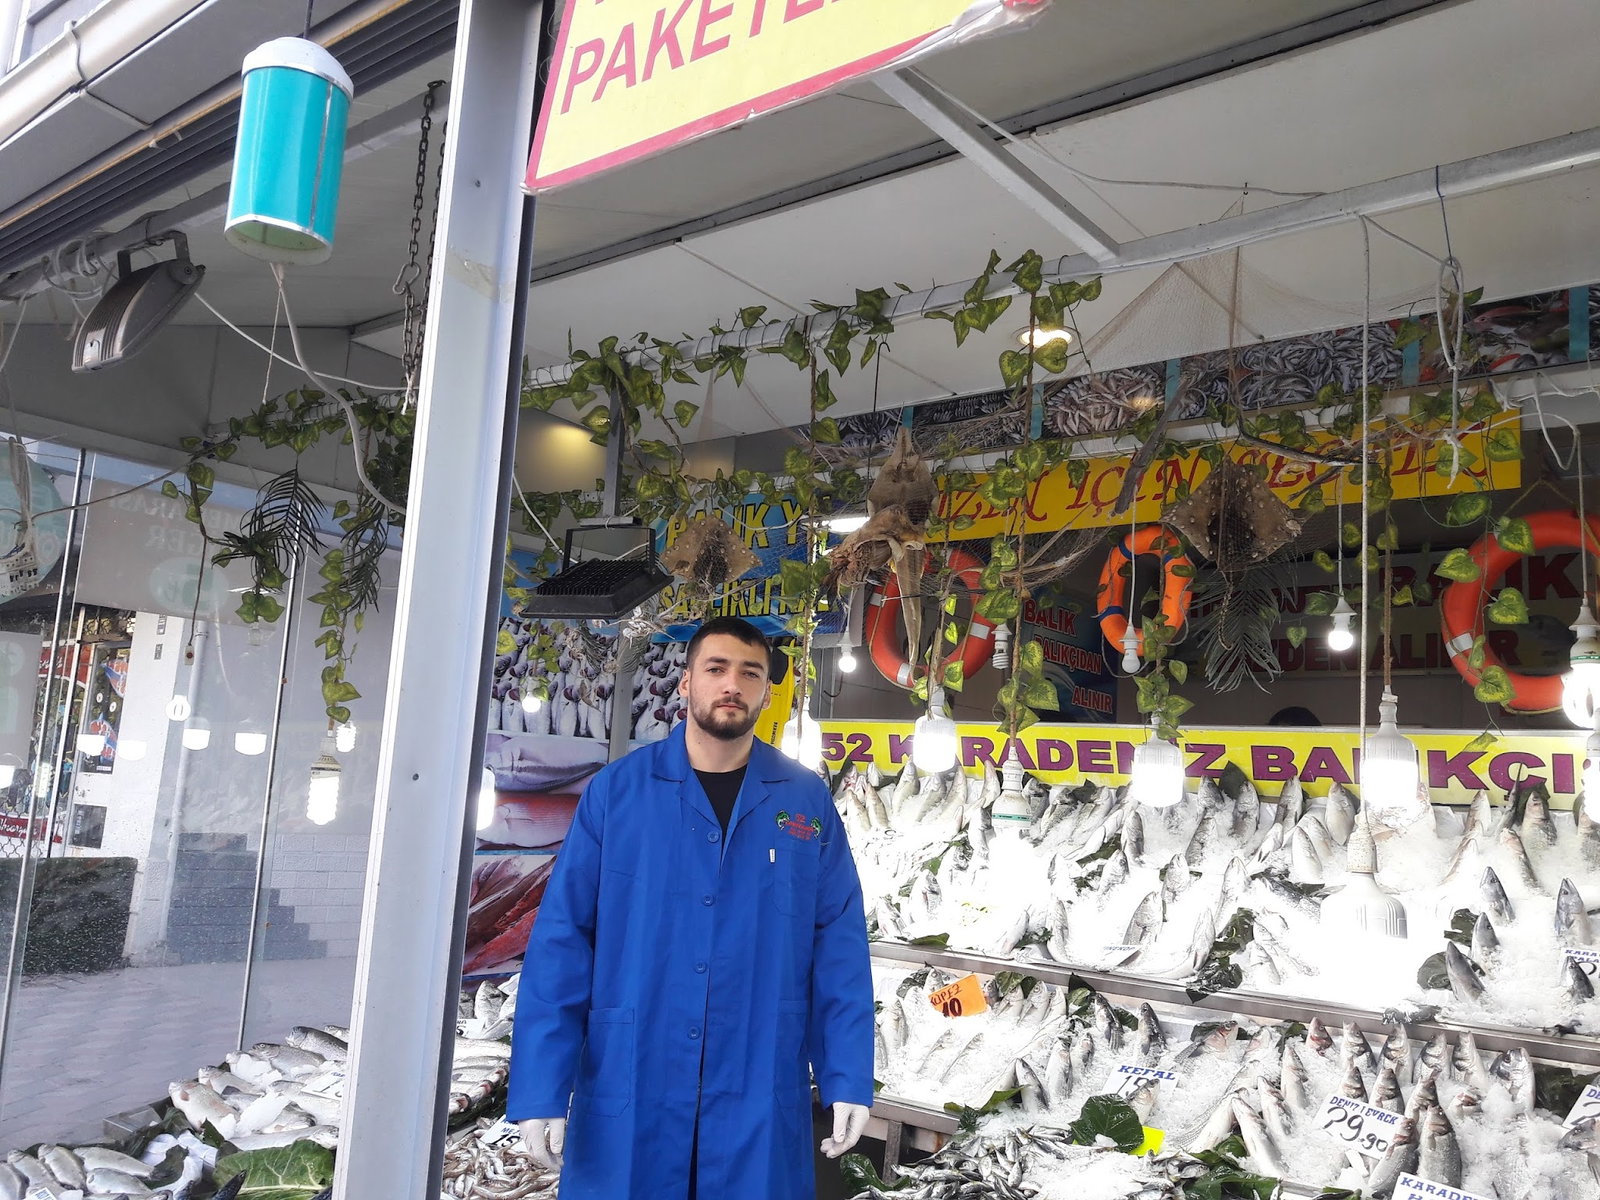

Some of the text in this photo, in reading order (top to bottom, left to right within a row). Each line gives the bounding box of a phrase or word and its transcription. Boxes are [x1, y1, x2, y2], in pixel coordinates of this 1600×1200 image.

[666, 502, 771, 549] BIK
[1379, 552, 1582, 607] BAIK
[1023, 598, 1077, 638] BALIK
[1071, 684, 1114, 715] ALINIR
[821, 732, 874, 763] 52
[888, 733, 1227, 779] KRADEZ
[942, 997, 963, 1018] 10
[1117, 1064, 1176, 1081] KEFAL
[1400, 1176, 1478, 1200] KARADE
